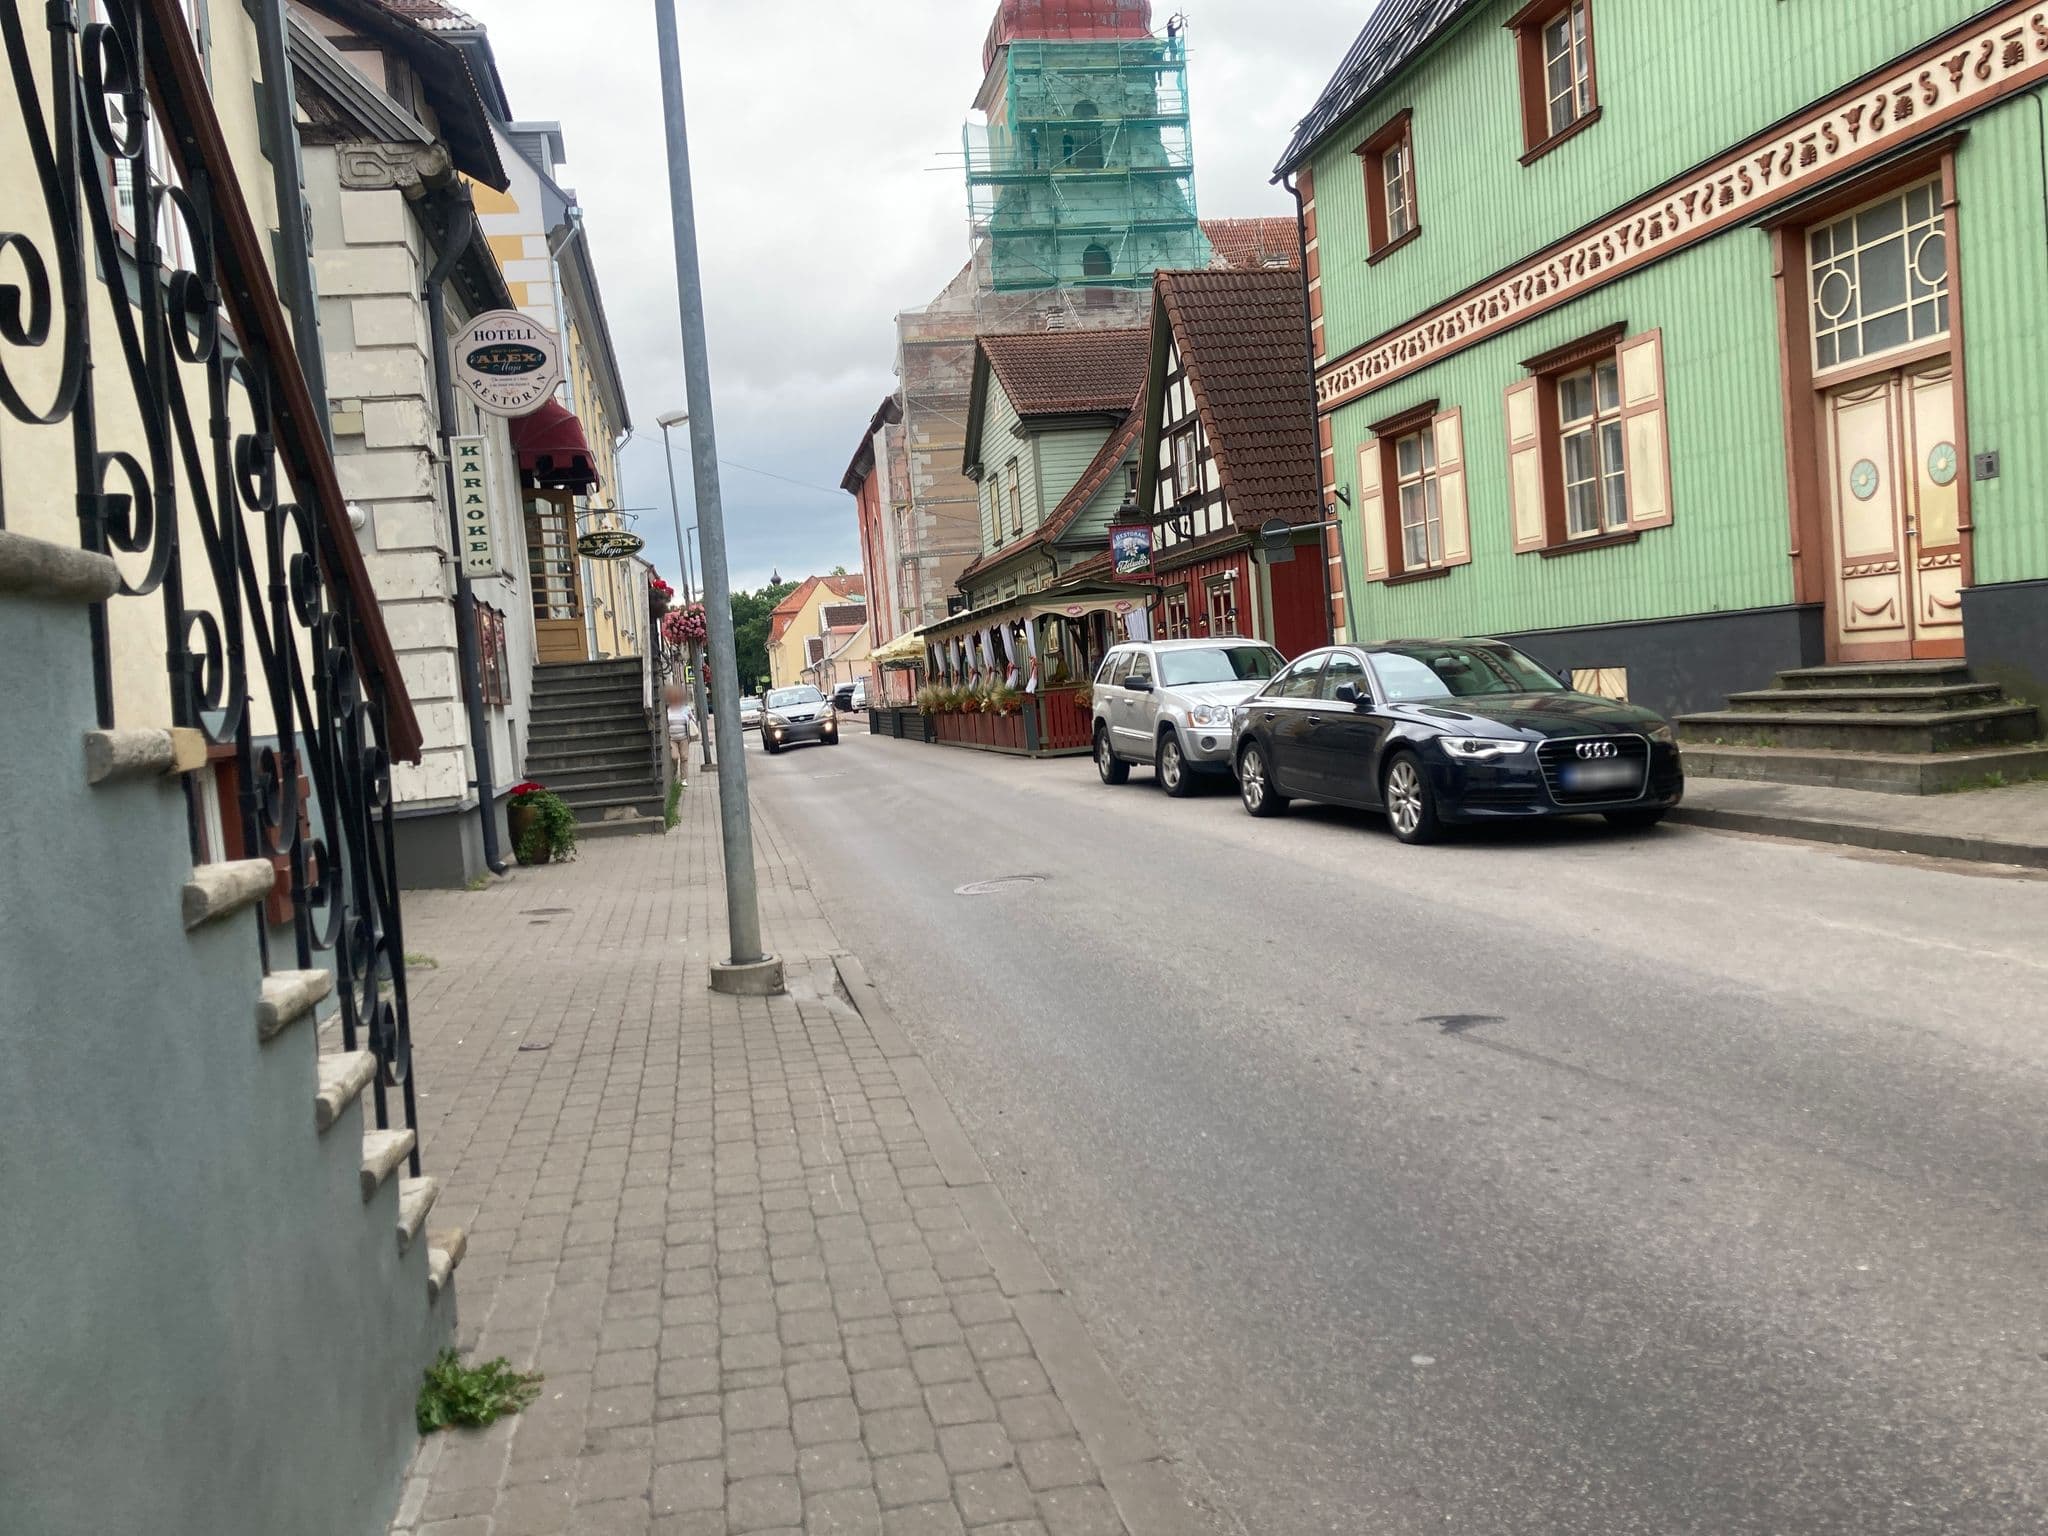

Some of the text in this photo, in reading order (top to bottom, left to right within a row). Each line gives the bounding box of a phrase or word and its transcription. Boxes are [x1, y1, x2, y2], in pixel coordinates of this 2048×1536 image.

[474, 329, 536, 341] HOTELL
[478, 352, 538, 364] ALEX
[472, 374, 546, 406] RESTORAN
[460, 446, 488, 552] KARAOKE
[1115, 531, 1146, 541] RESTORAN
[578, 537, 637, 548] ALEX
